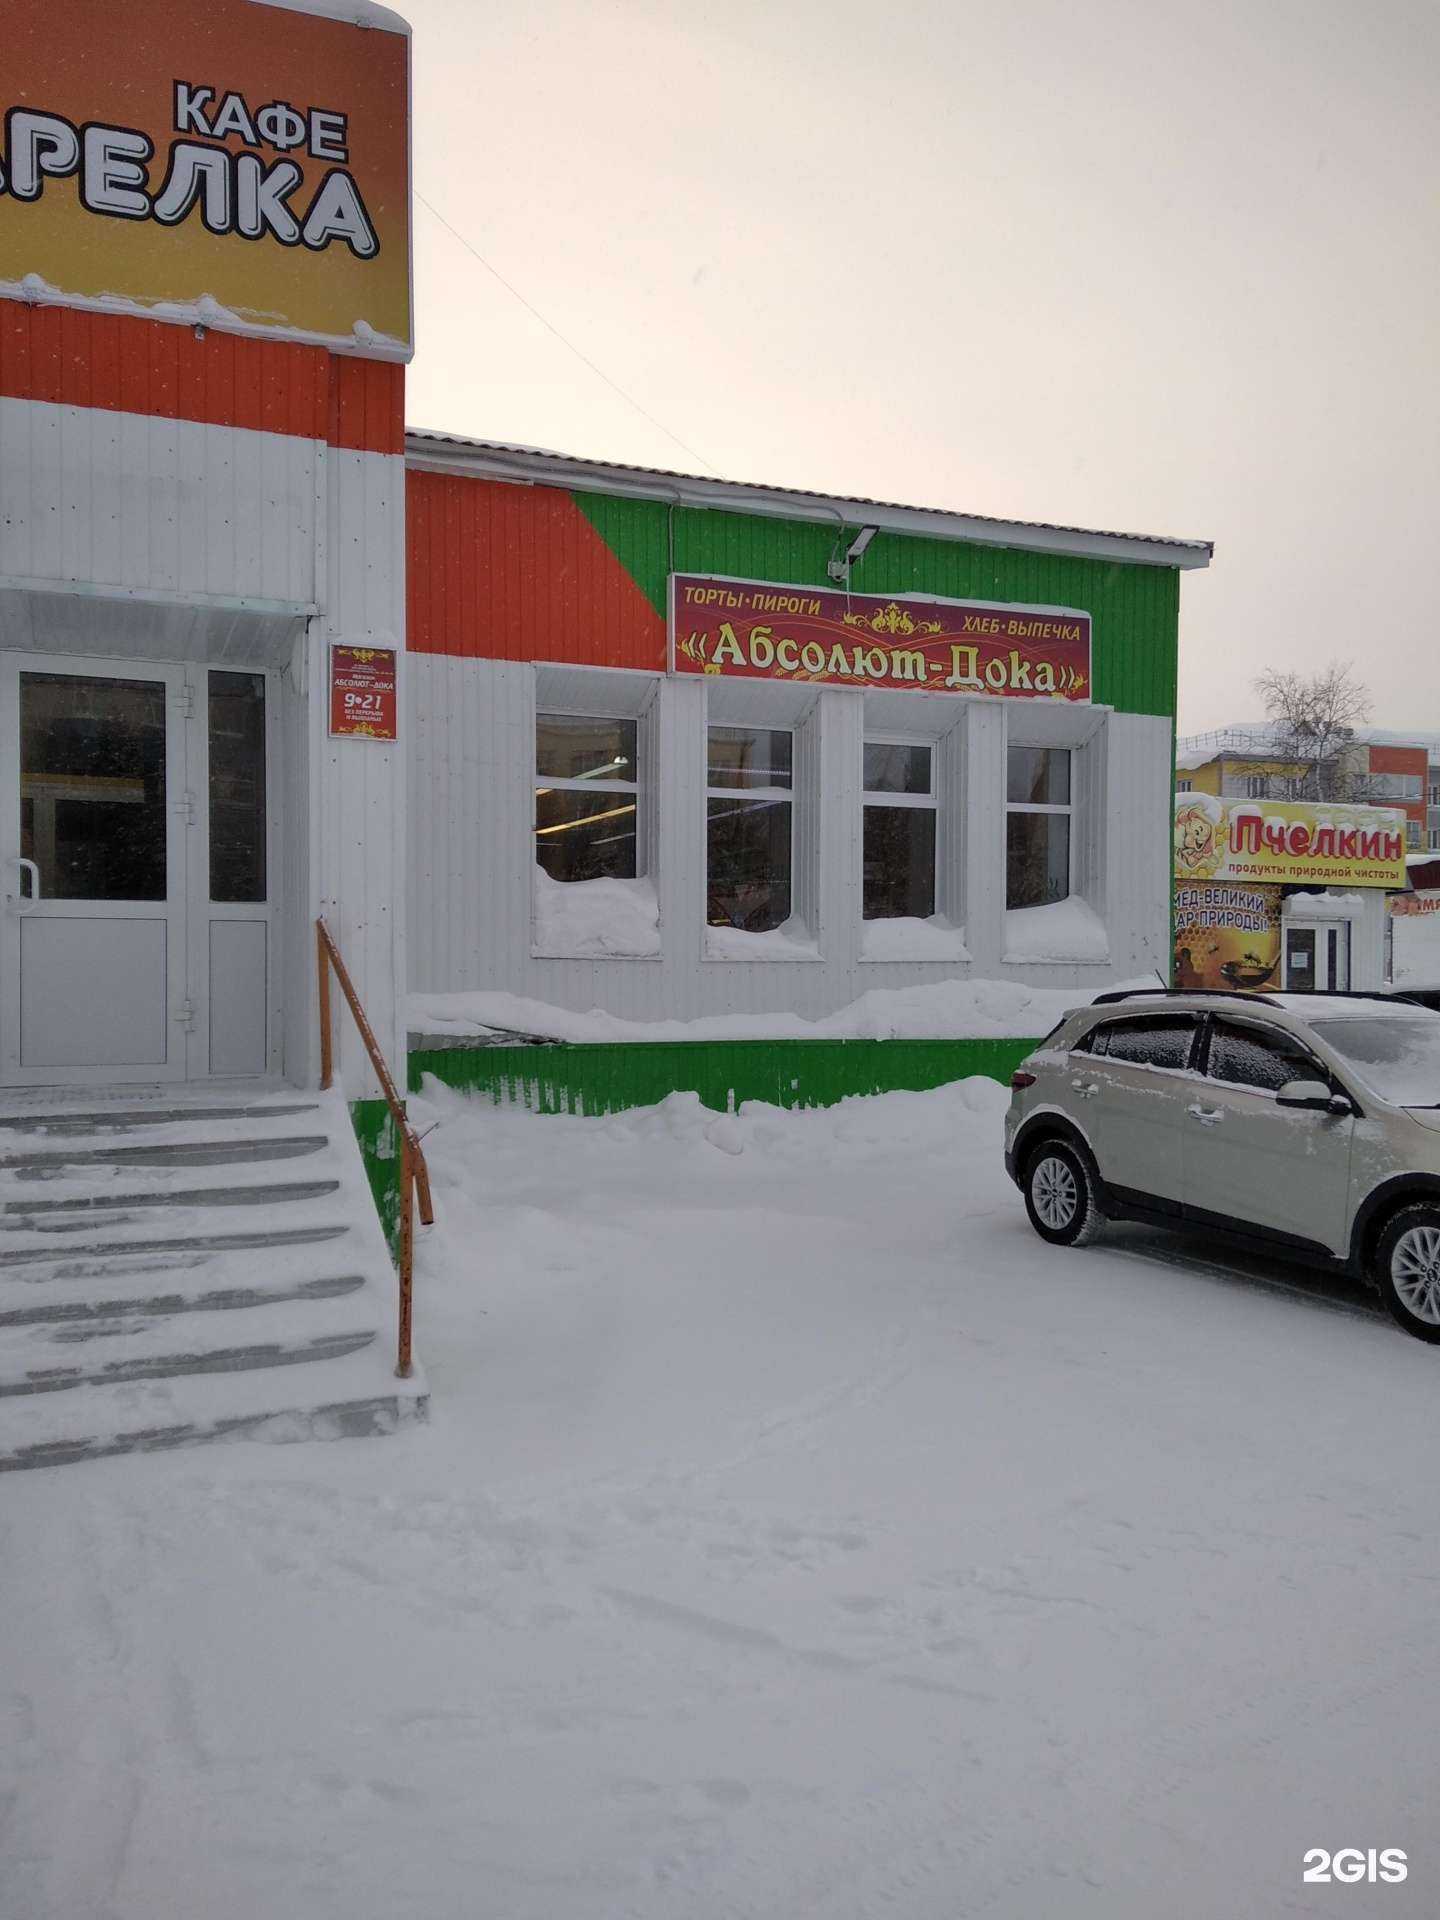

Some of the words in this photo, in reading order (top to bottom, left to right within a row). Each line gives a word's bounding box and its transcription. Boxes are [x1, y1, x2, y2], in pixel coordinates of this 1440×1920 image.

[173, 79, 349, 163] КАФЕ
[0, 106, 380, 260] РЕЛКА
[1229, 814, 1402, 862] Пчелкин
[1228, 862, 1286, 876] продукты
[1289, 864, 1352, 879] природной
[1354, 869, 1399, 880] чистоты
[1173, 911, 1195, 930] АР
